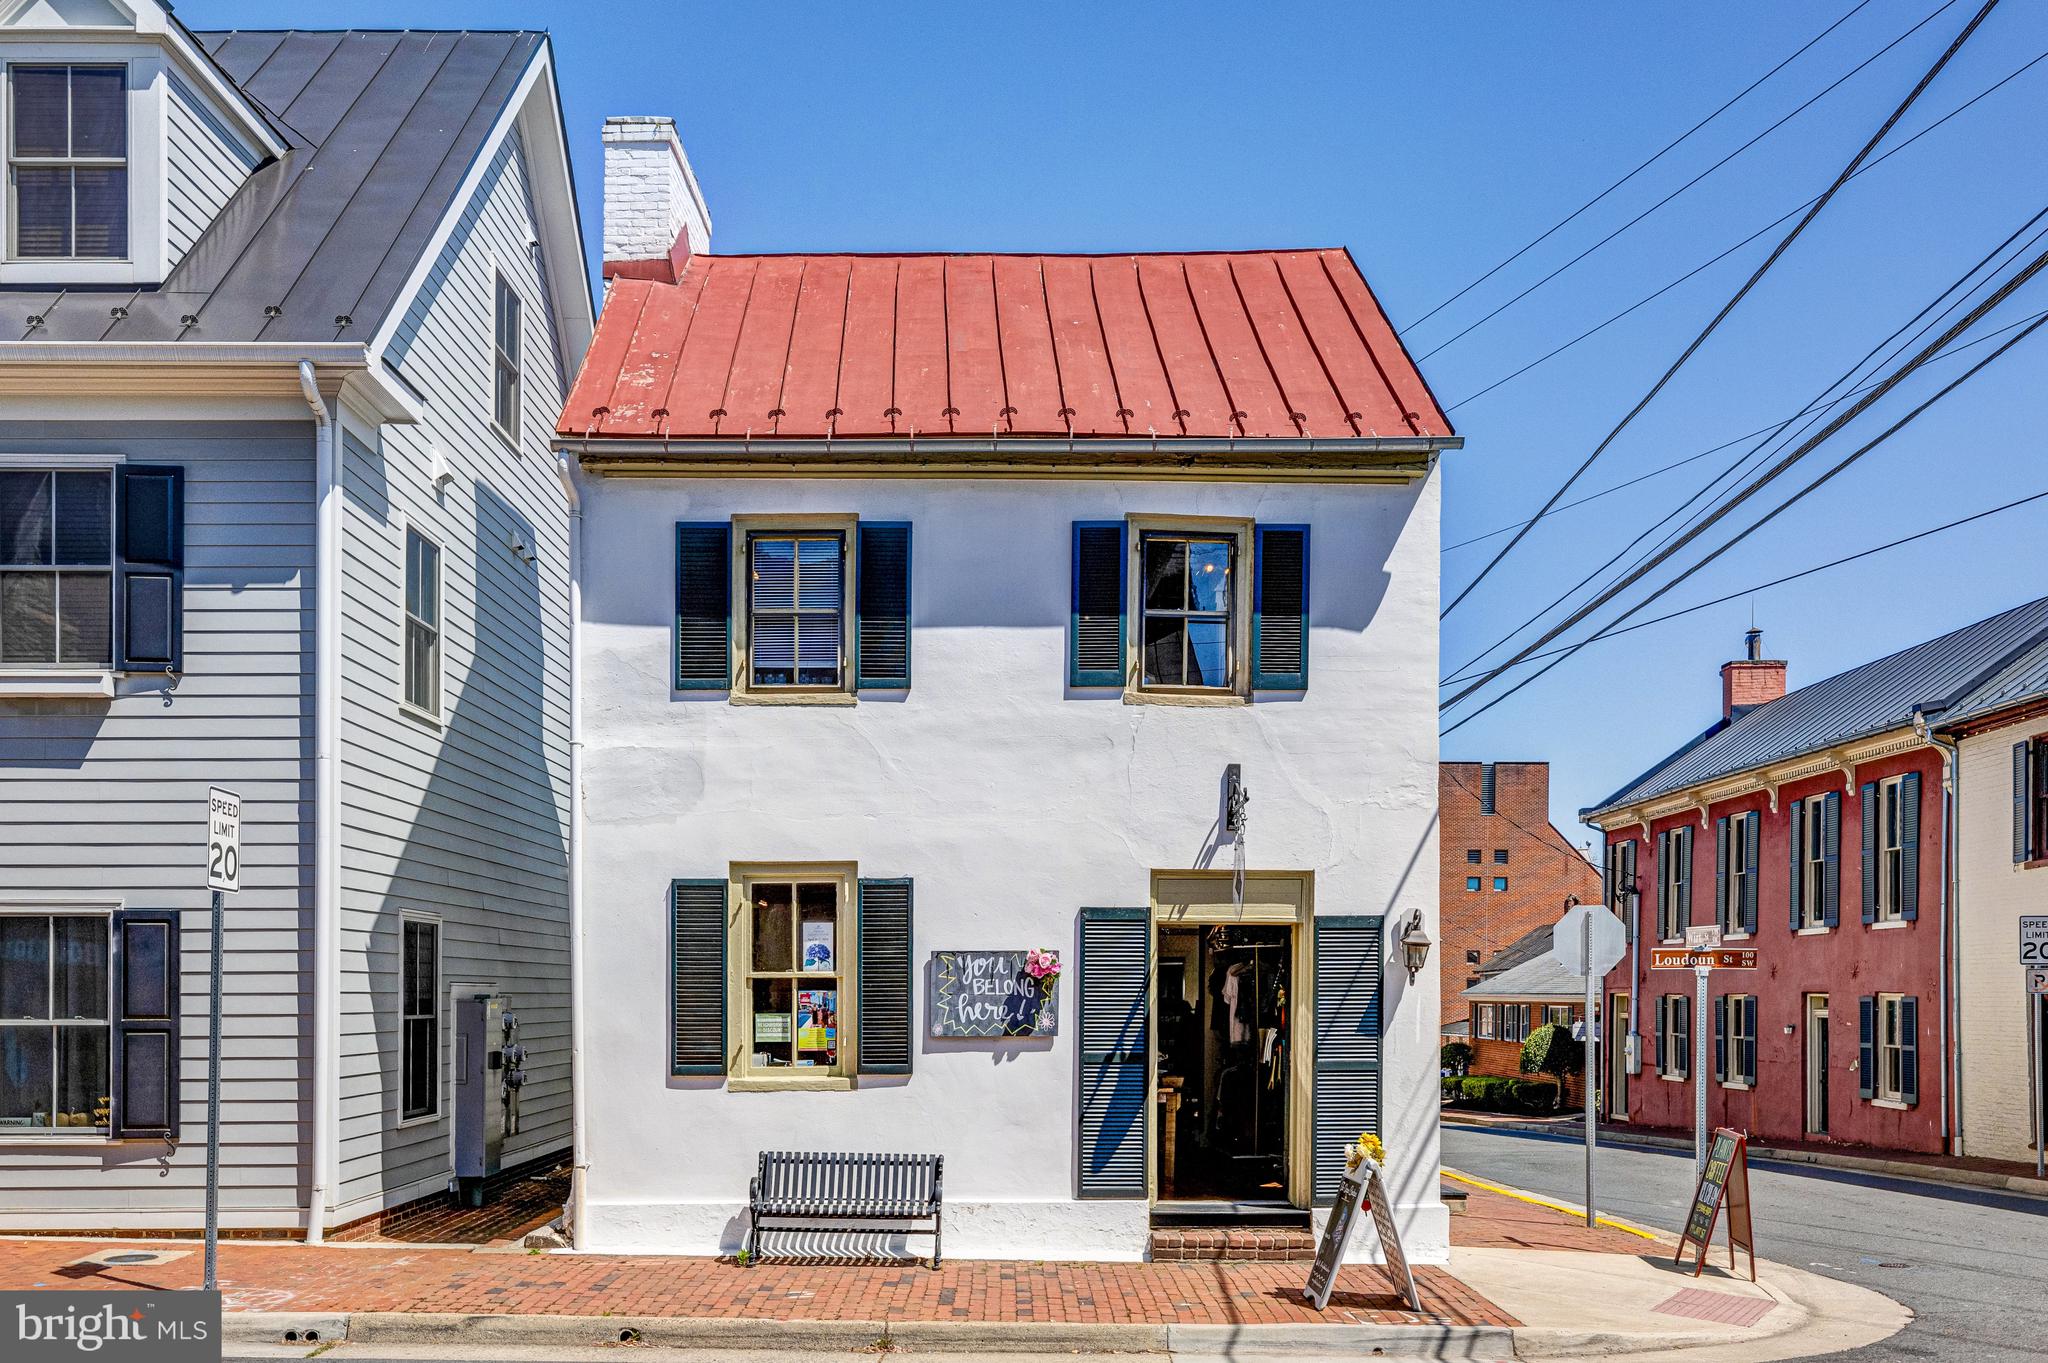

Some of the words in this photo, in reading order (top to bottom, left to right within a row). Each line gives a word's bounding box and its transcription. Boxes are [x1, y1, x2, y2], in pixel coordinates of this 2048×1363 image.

[211, 798, 238, 818] SPEED
[214, 820, 235, 838] LIMIT
[210, 842, 237, 881] 20
[1655, 953, 1715, 966] Loudoun
[1723, 955, 1733, 963] St
[972, 977, 1035, 998] BELONG
[1705, 1160, 1728, 1184] COFFEE
